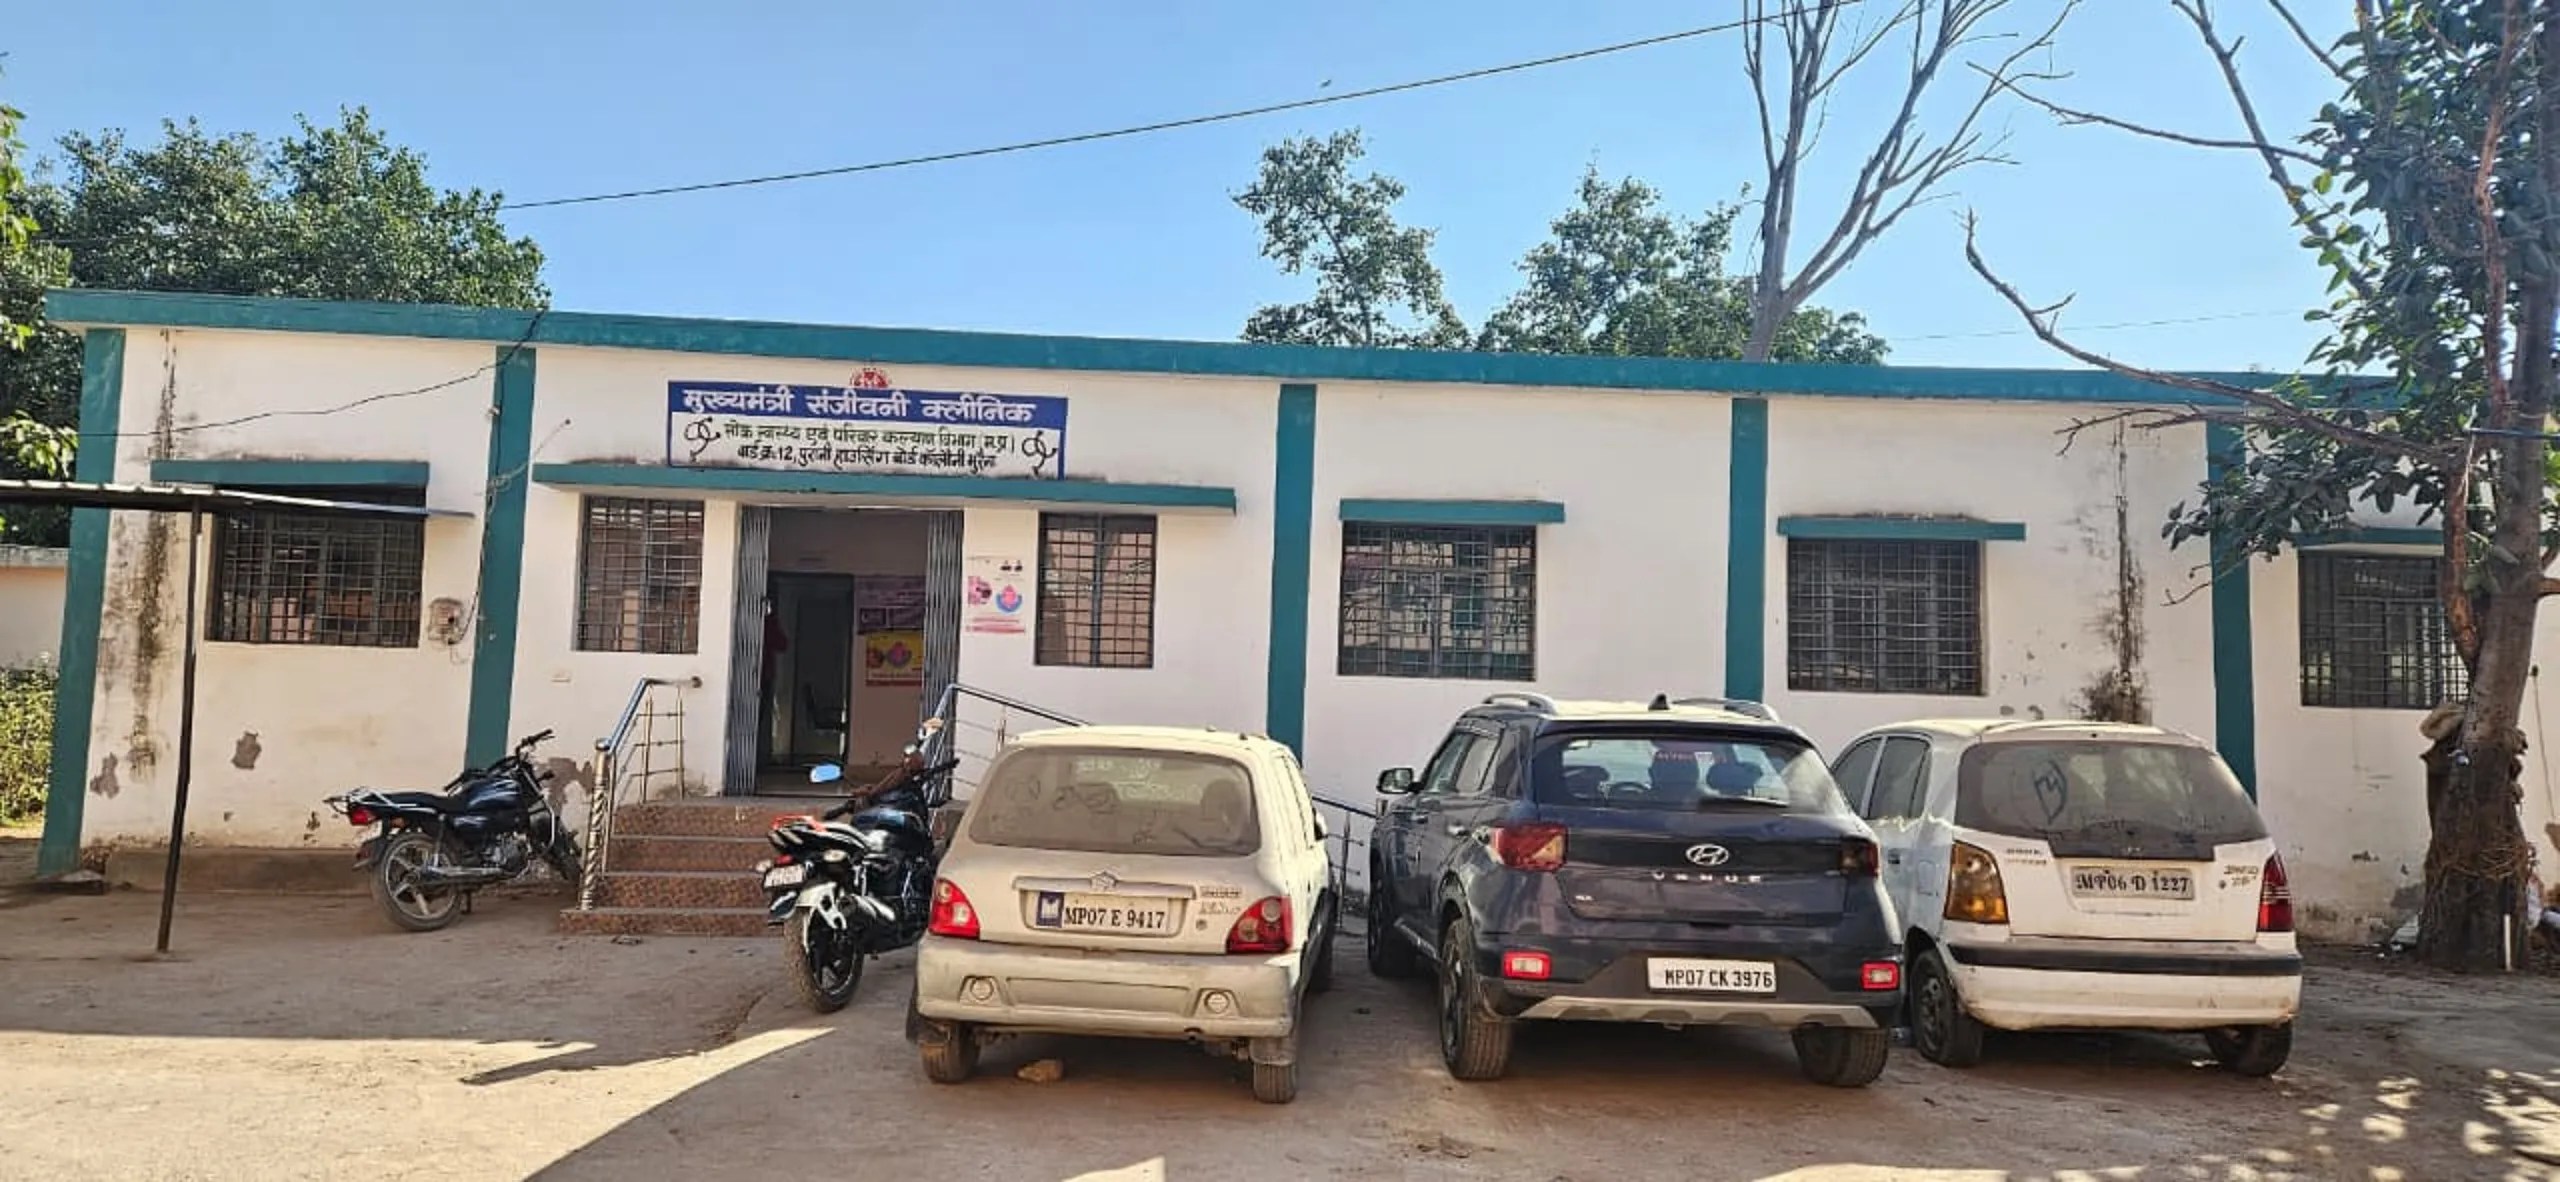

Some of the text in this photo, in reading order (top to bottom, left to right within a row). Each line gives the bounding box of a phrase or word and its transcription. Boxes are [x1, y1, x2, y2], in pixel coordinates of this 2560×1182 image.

[683, 385, 1037, 422] मुख्यमंत्री संजीवनी क्लीनिक
[833, 422, 878, 442] परिवार
[881, 431, 936, 446] कल्याण
[938, 425, 976, 448] विभाग
[798, 441, 832, 466] पुरानी
[1652, 871, 1761, 883] VENUE
[2075, 873, 2189, 892] MP06 D 1227
[1065, 907, 1165, 929] MP07 E 9417
[1664, 969, 1773, 988] MP07 CK 3976
